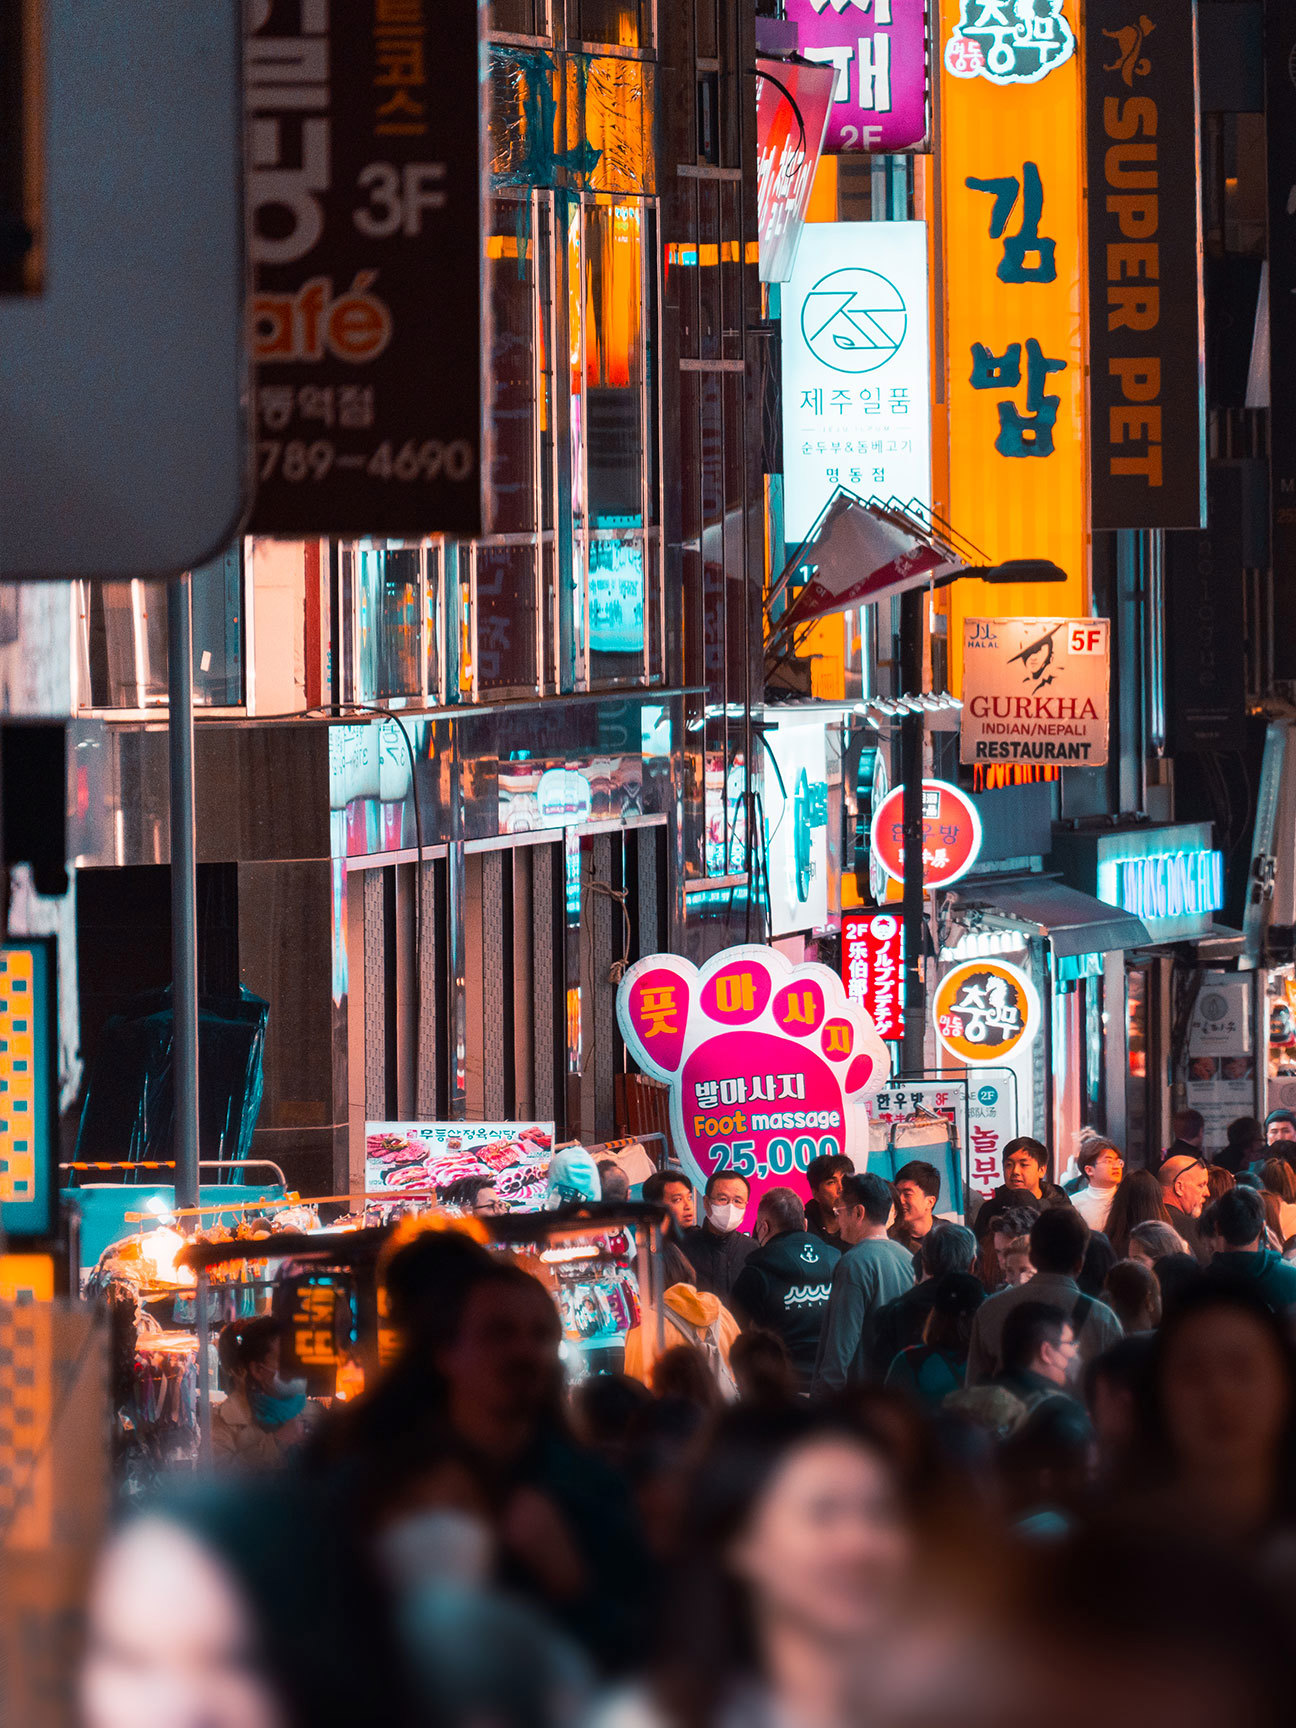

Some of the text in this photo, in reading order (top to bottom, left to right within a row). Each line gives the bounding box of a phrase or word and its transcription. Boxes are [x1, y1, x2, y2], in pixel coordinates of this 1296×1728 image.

[840, 125, 883, 151] 2F
[352, 162, 447, 237] 3F
[1103, 95, 1164, 488] SUPER PET
[248, 268, 393, 363] afé
[964, 160, 1068, 458] 김밥
[800, 387, 911, 416] 제주일품
[826, 466, 886, 484] 명동점
[1071, 629, 1101, 652] 5F
[969, 695, 1099, 721] GURKHA
[981, 722, 1087, 738] INDIAN/NEPALI
[976, 740, 1092, 761] RESTAURANT
[845, 923, 869, 940] 2F
[694, 1073, 806, 1109] 발마사지
[935, 1092, 948, 1106] 3F
[693, 1109, 749, 1138] Foot
[750, 1109, 842, 1131] massage
